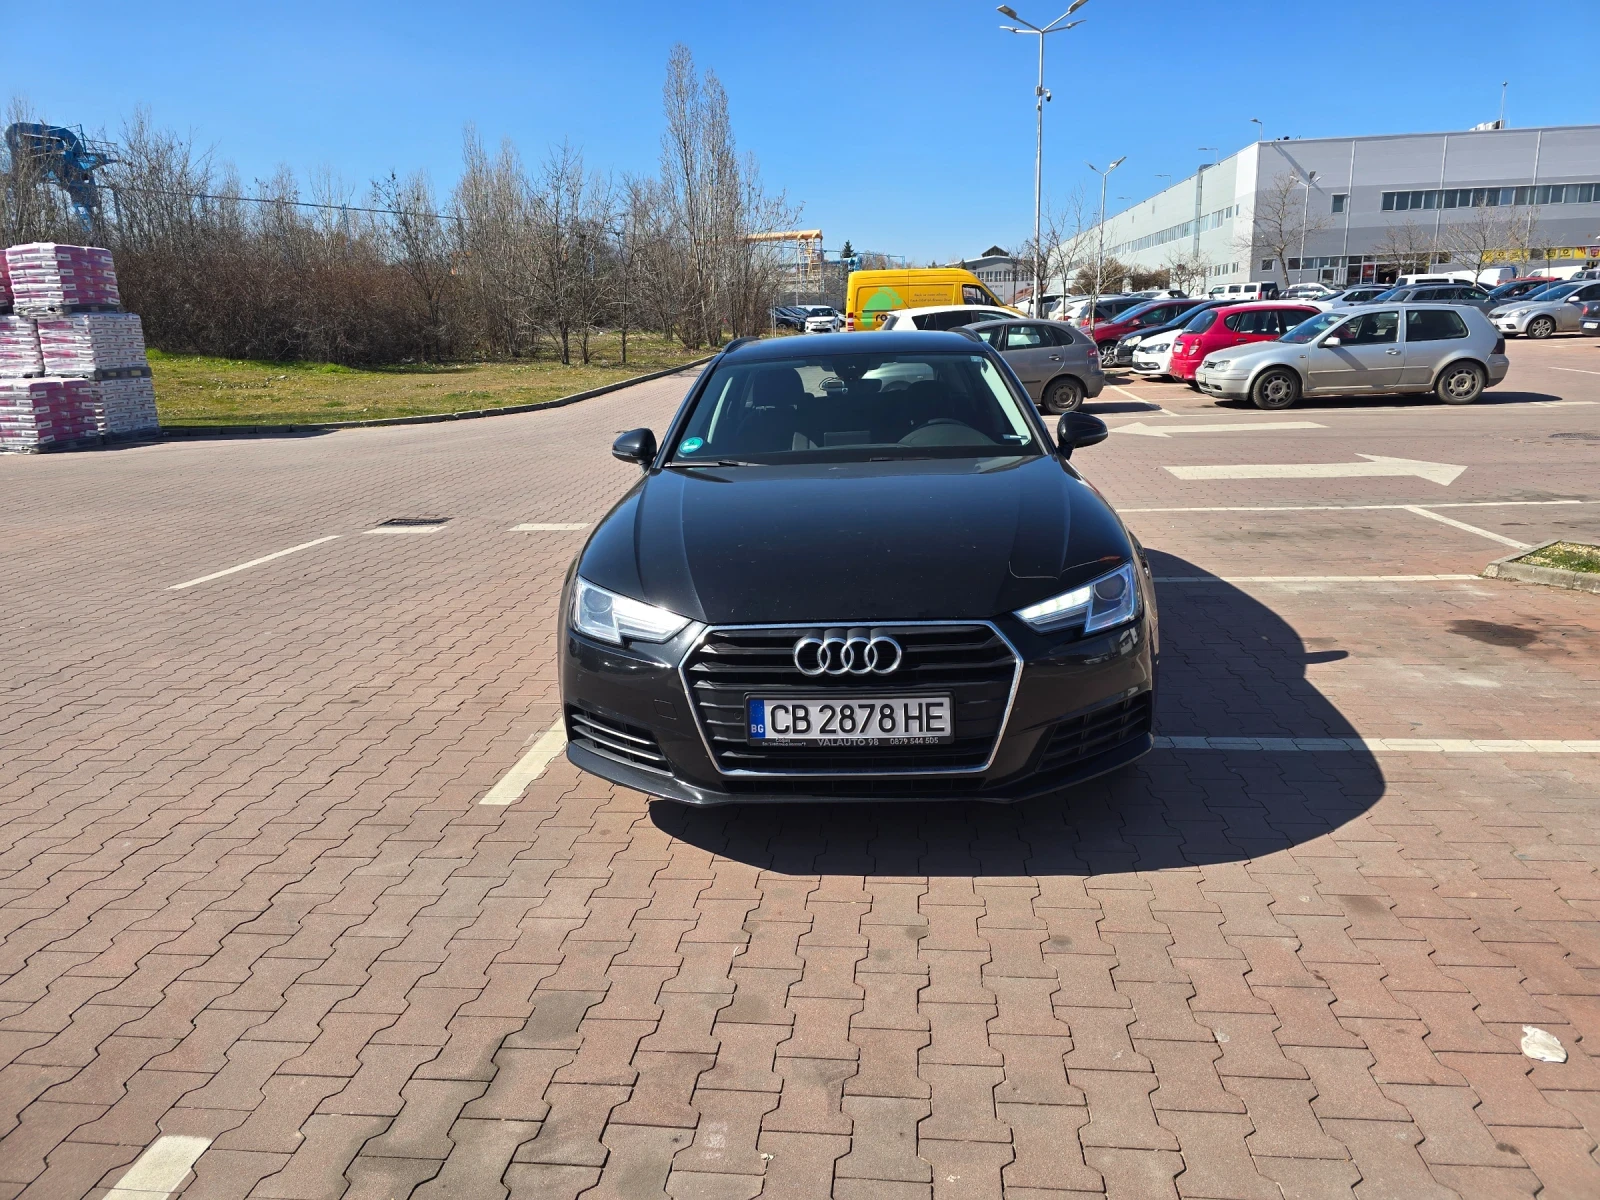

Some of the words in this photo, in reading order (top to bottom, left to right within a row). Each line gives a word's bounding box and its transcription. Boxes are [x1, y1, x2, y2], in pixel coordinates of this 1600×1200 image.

[770, 704, 811, 734] CB
[818, 703, 896, 734] 2878
[903, 702, 945, 733] HE
[751, 724, 764, 733] BG
[817, 738, 866, 746] VALAUTO
[868, 738, 879, 746] 98
[925, 736, 939, 744] 505
